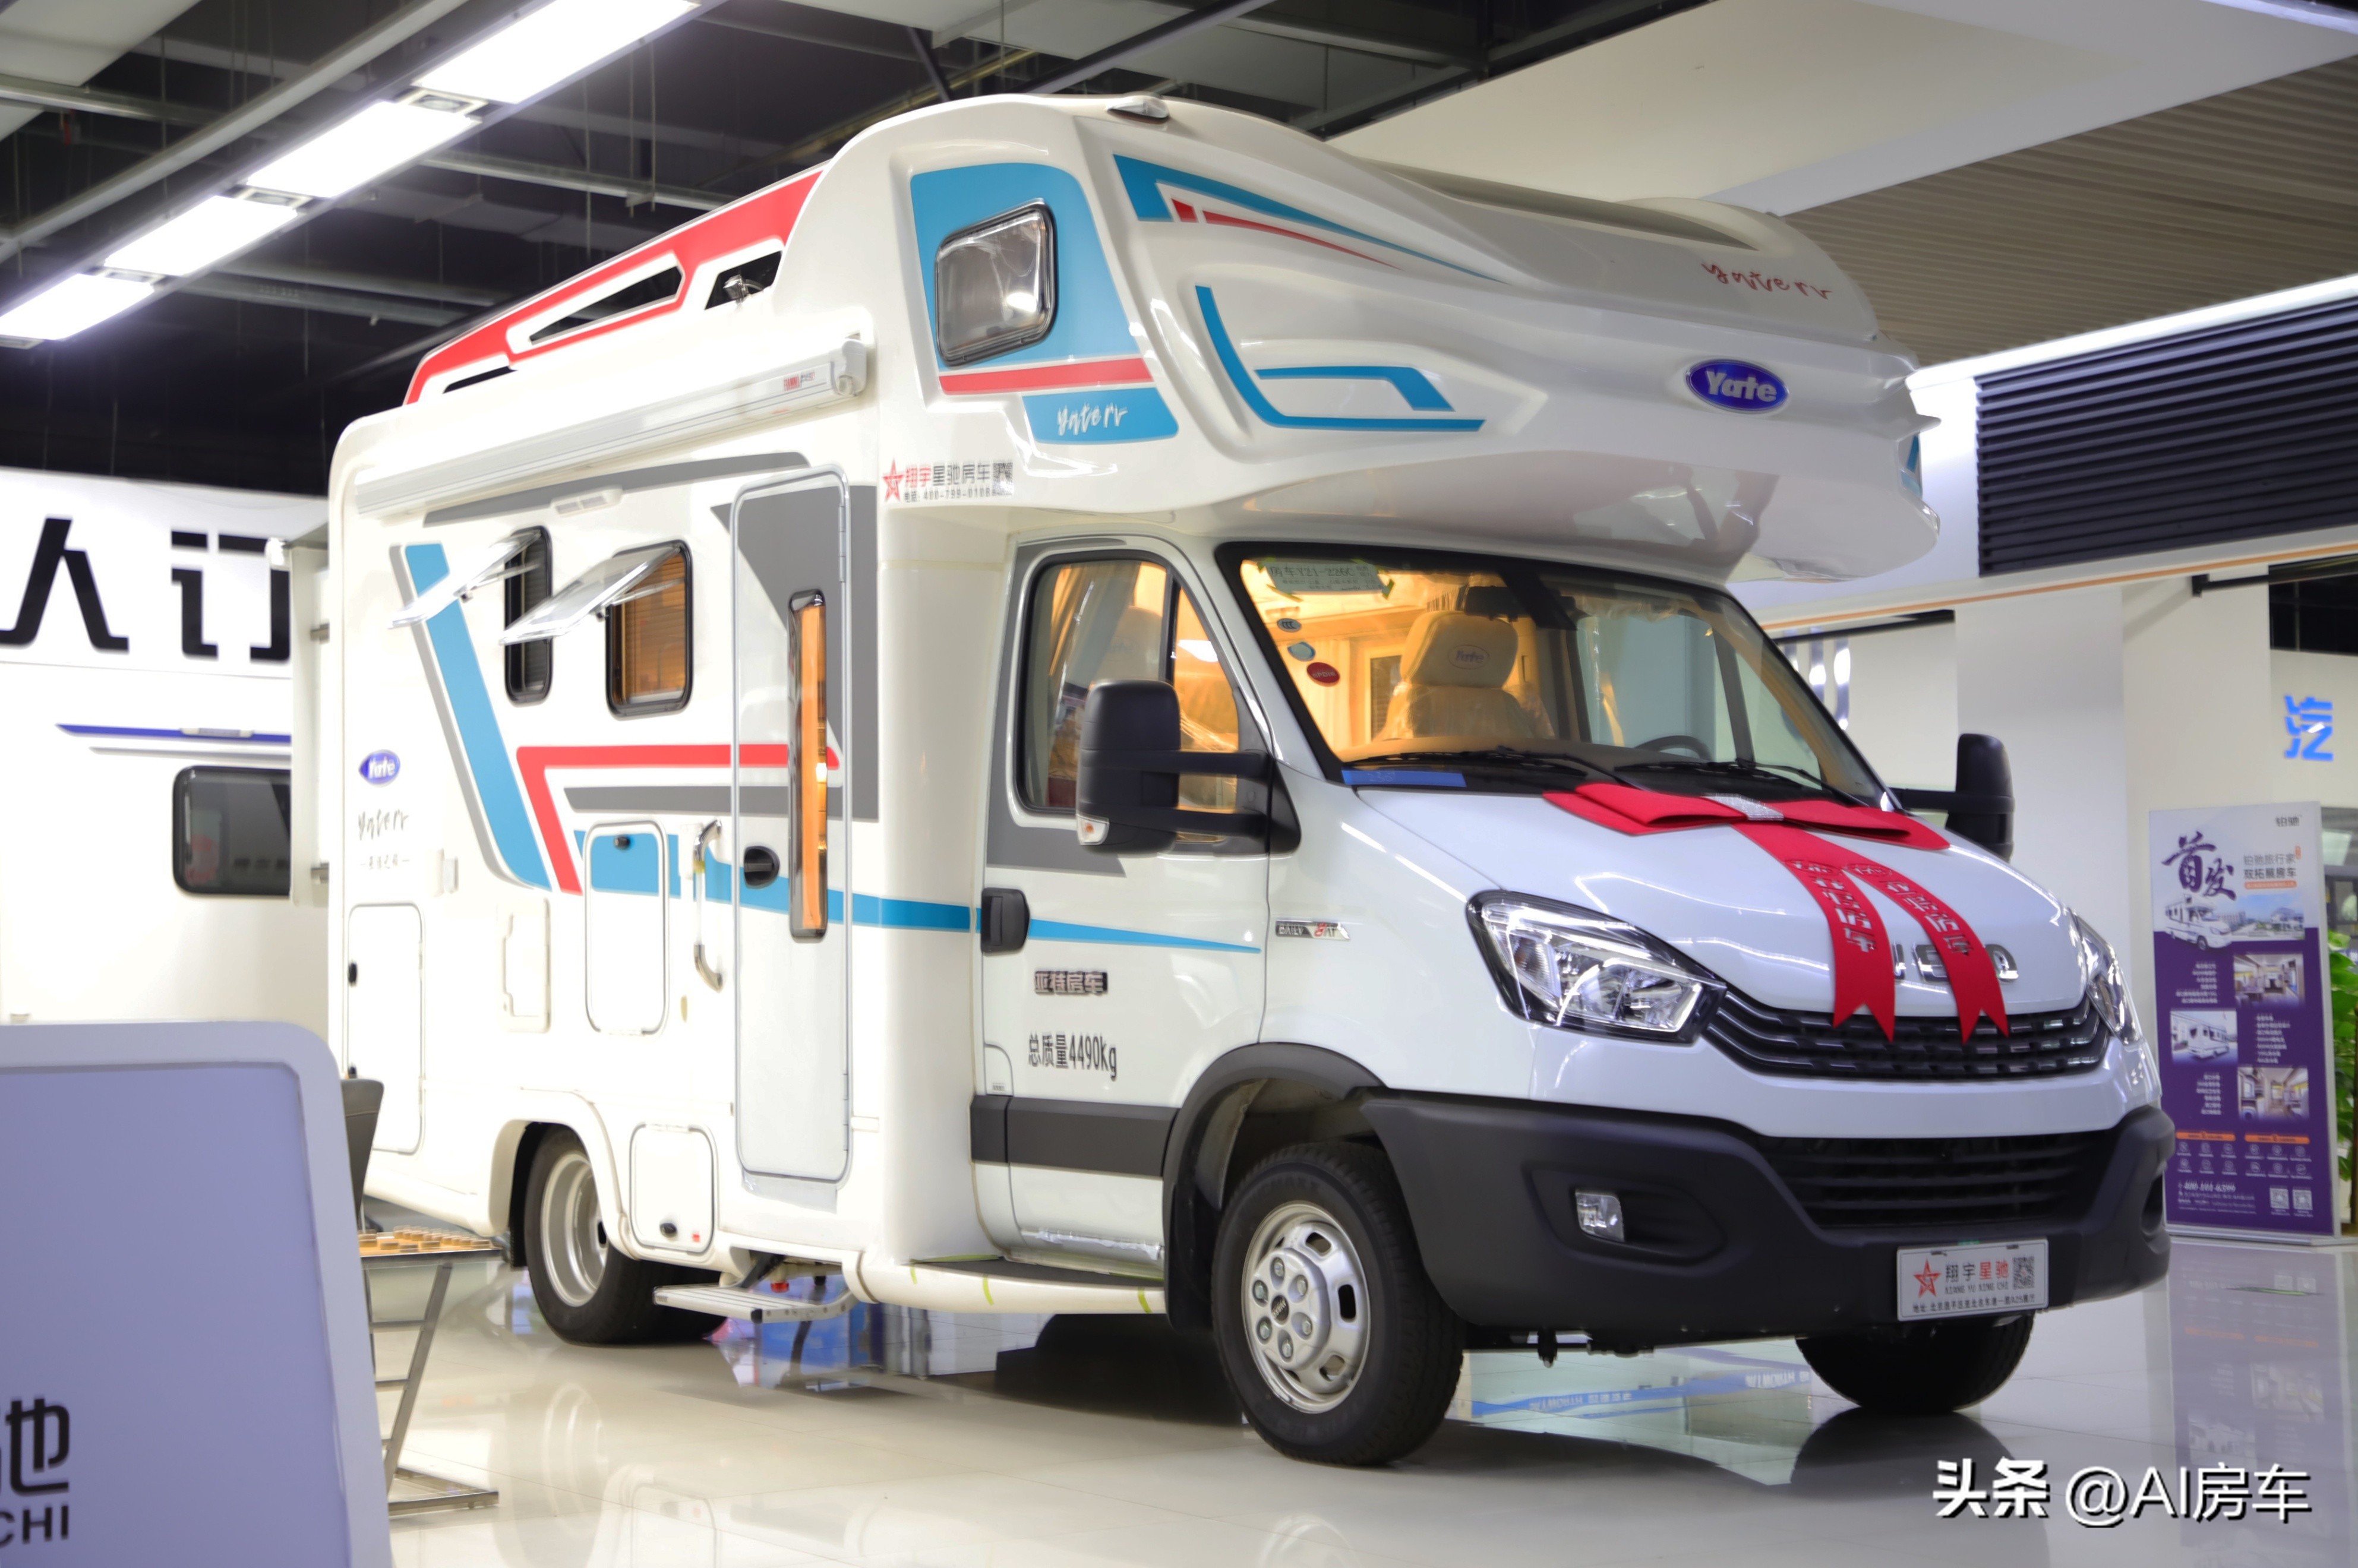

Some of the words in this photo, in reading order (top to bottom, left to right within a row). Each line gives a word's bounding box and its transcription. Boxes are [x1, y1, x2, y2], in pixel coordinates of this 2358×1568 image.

[1704, 369, 1778, 403] Yate
[905, 462, 991, 488] 翔宇星驰房车
[2161, 830, 2236, 901] 首发
[1034, 971, 1106, 994] 亚特房车
[1028, 1032, 1117, 1082] 总质量4490kg
[1945, 1260, 2009, 1284] 翔宇星驰
